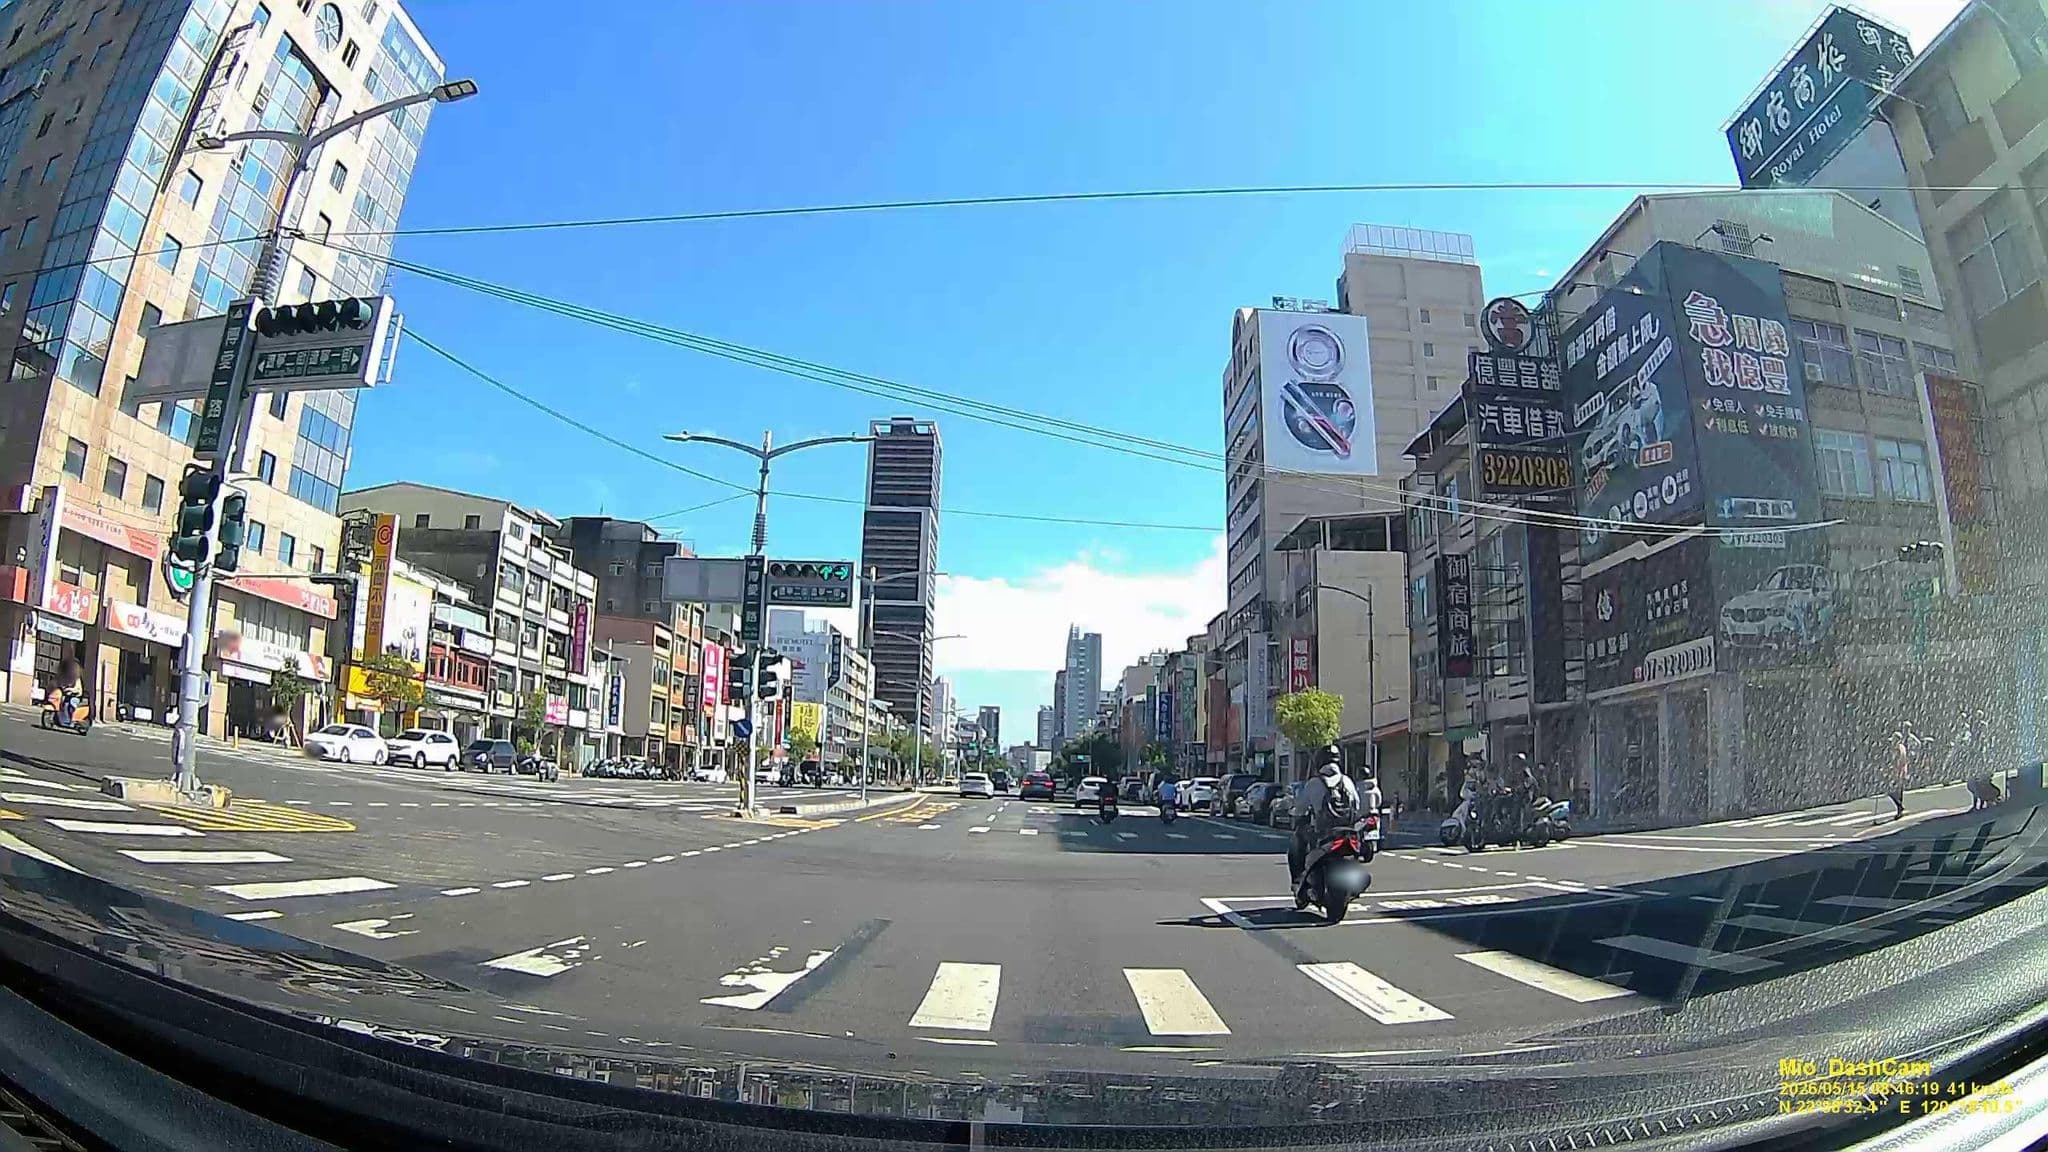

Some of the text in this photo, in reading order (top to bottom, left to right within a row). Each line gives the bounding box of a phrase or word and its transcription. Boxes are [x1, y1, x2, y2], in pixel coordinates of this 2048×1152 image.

[1770, 105, 1843, 182] Royal Hotel
[1683, 290, 1789, 357] 急用錢
[1475, 355, 1560, 391] 億豐當舖
[1701, 347, 1791, 396] 找億豐
[1479, 403, 1566, 438] 汽車借款
[1484, 453, 1570, 488] 3220303
[1447, 556, 1470, 657] 御宿商旅
